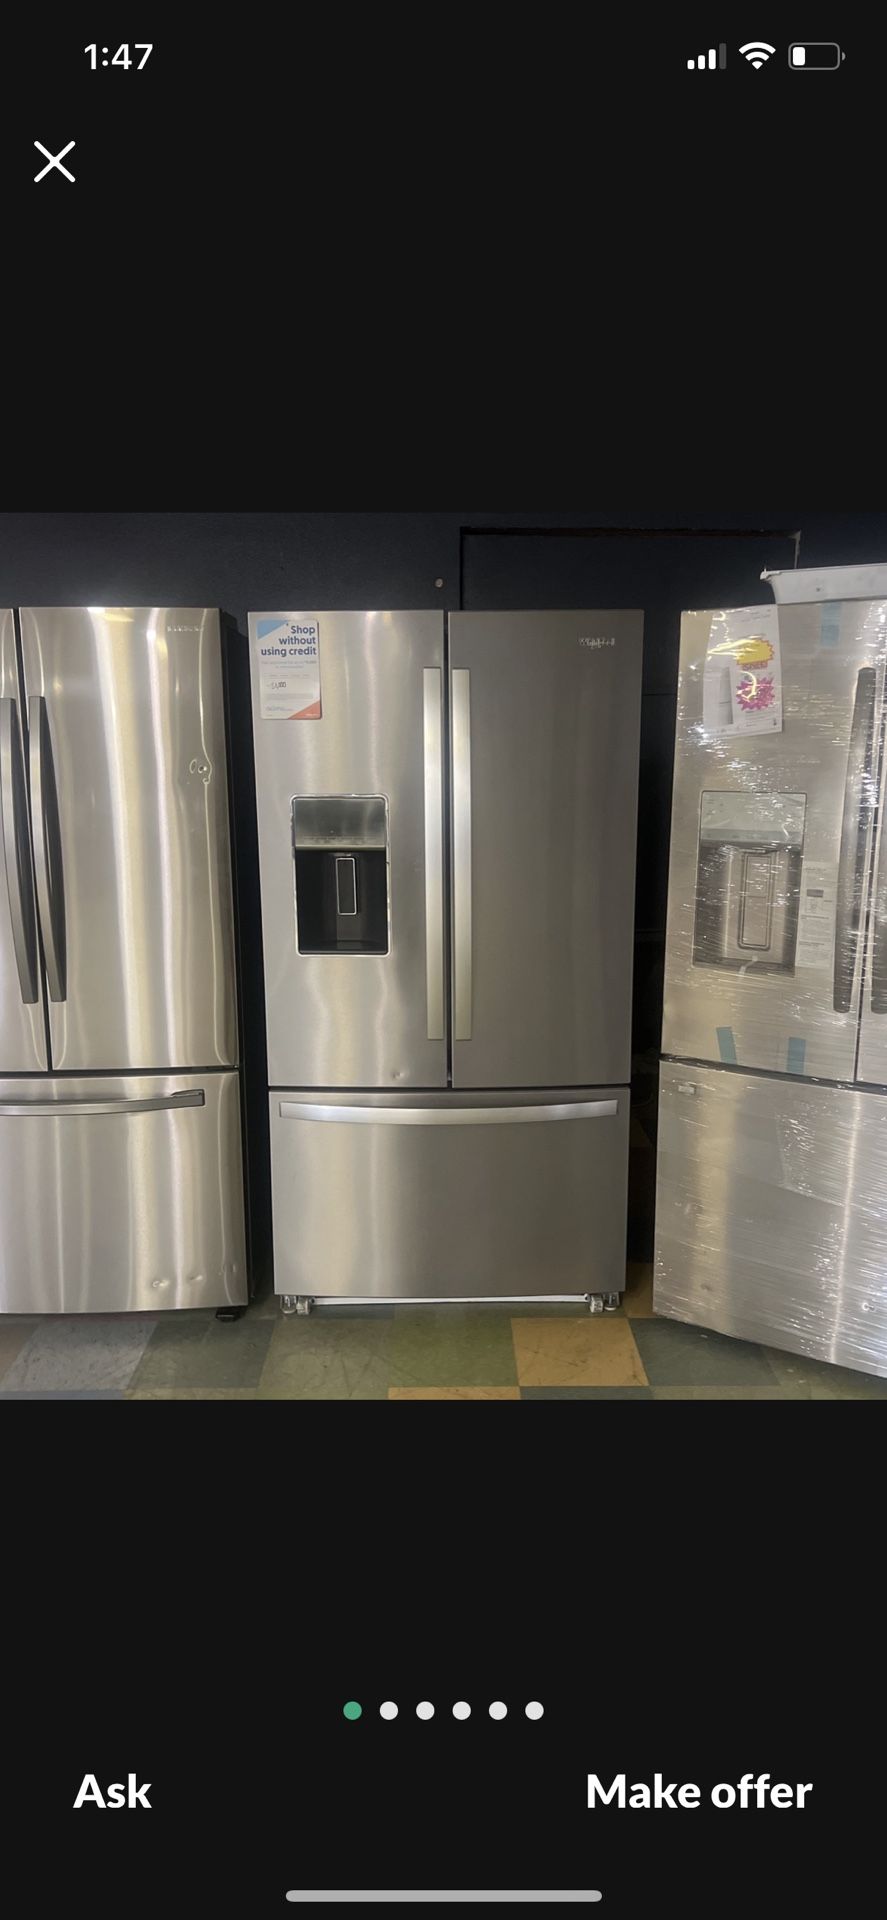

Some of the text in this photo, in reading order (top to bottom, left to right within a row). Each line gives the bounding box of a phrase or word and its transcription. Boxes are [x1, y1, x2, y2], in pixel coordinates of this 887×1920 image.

[290, 625, 316, 636] Shop
[279, 636, 316, 645] without
[261, 646, 317, 657] using credit
